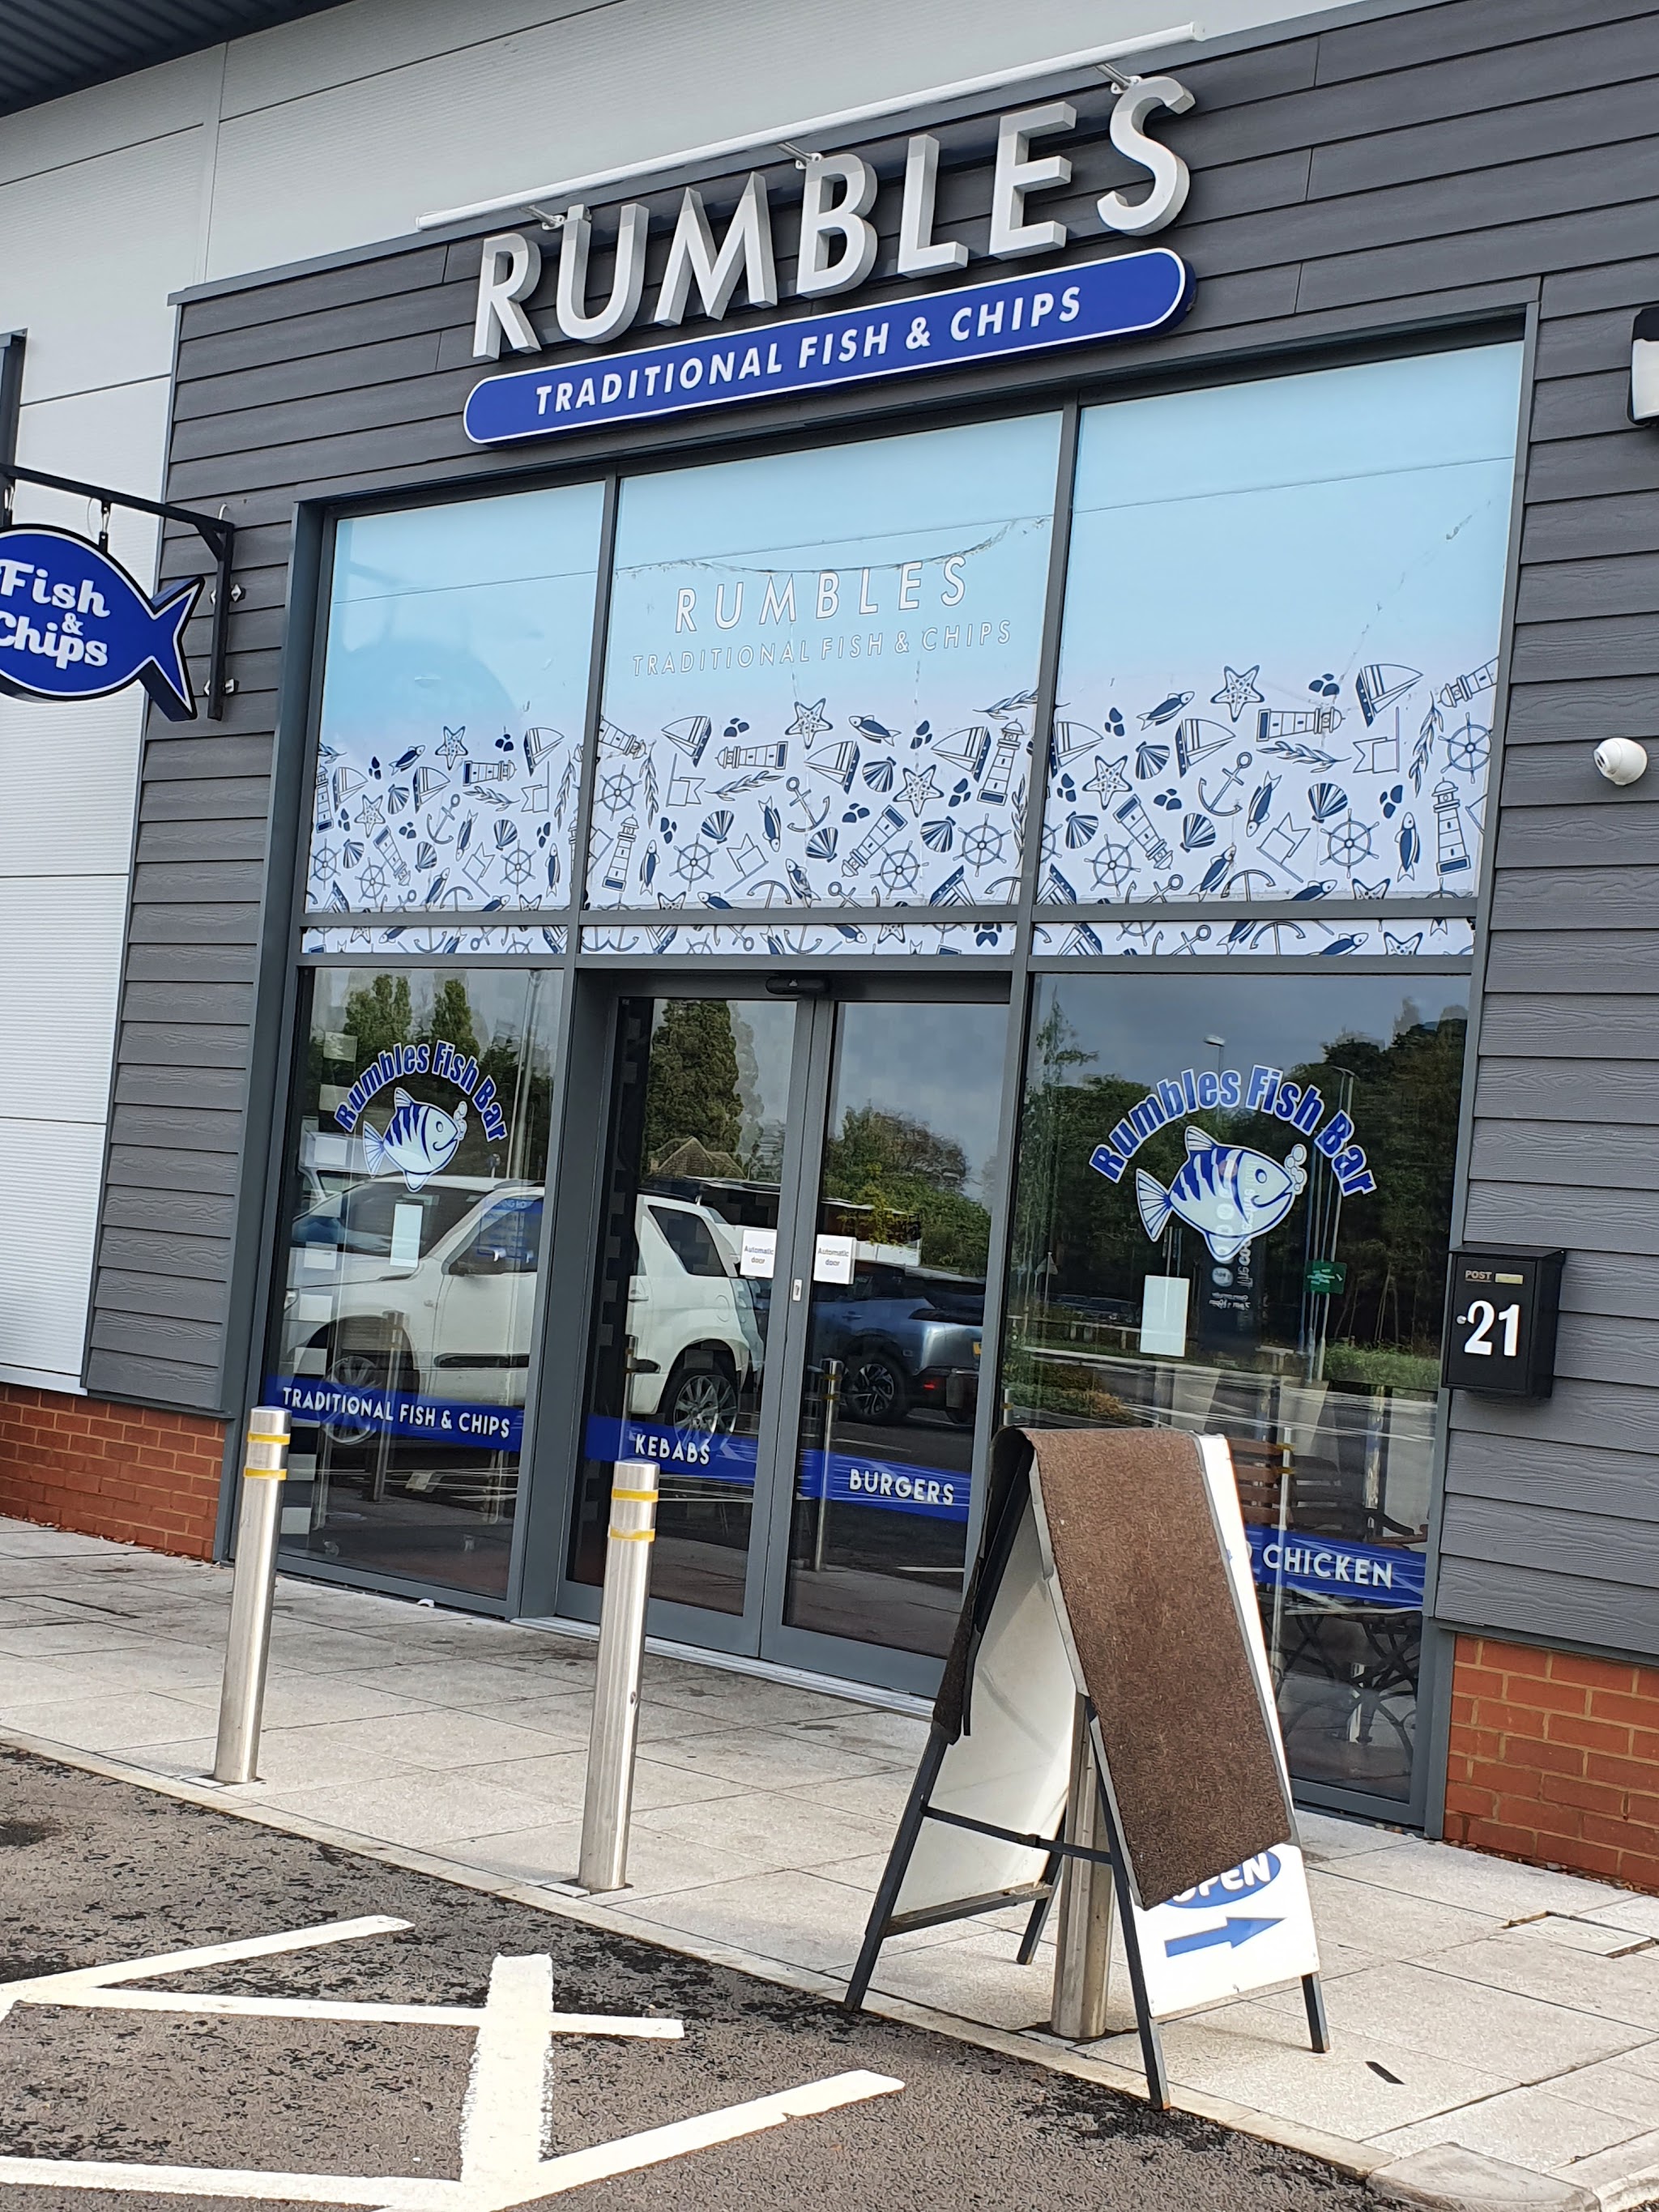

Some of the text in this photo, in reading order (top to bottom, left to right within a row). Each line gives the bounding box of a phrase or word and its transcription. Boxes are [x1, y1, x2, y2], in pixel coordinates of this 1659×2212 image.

[473, 75, 1196, 360] RUMBLES
[535, 286, 1081, 416] TRADITIONAL FISH & CHIPS
[0, 558, 111, 618] Fish
[675, 556, 966, 633] RUMBLES
[62, 612, 83, 636] &
[633, 620, 1012, 677] TRADITIONAL FISH & CHIPS
[333, 1039, 509, 1143] Rumbles Fish Bar
[1089, 1064, 1377, 1197] Rumbles Fish Bar
[744, 1245, 774, 1255] Automatic
[817, 1247, 849, 1257] Automatic
[1465, 1270, 1492, 1280] POST
[1464, 1300, 1520, 1357] 21
[283, 1387, 510, 1439] TRADITIONAL FISH & CHIPS
[634, 1433, 710, 1465] KEBABS
[849, 1468, 954, 1505] BURGERS
[1262, 1544, 1392, 1590] CHICKEN
